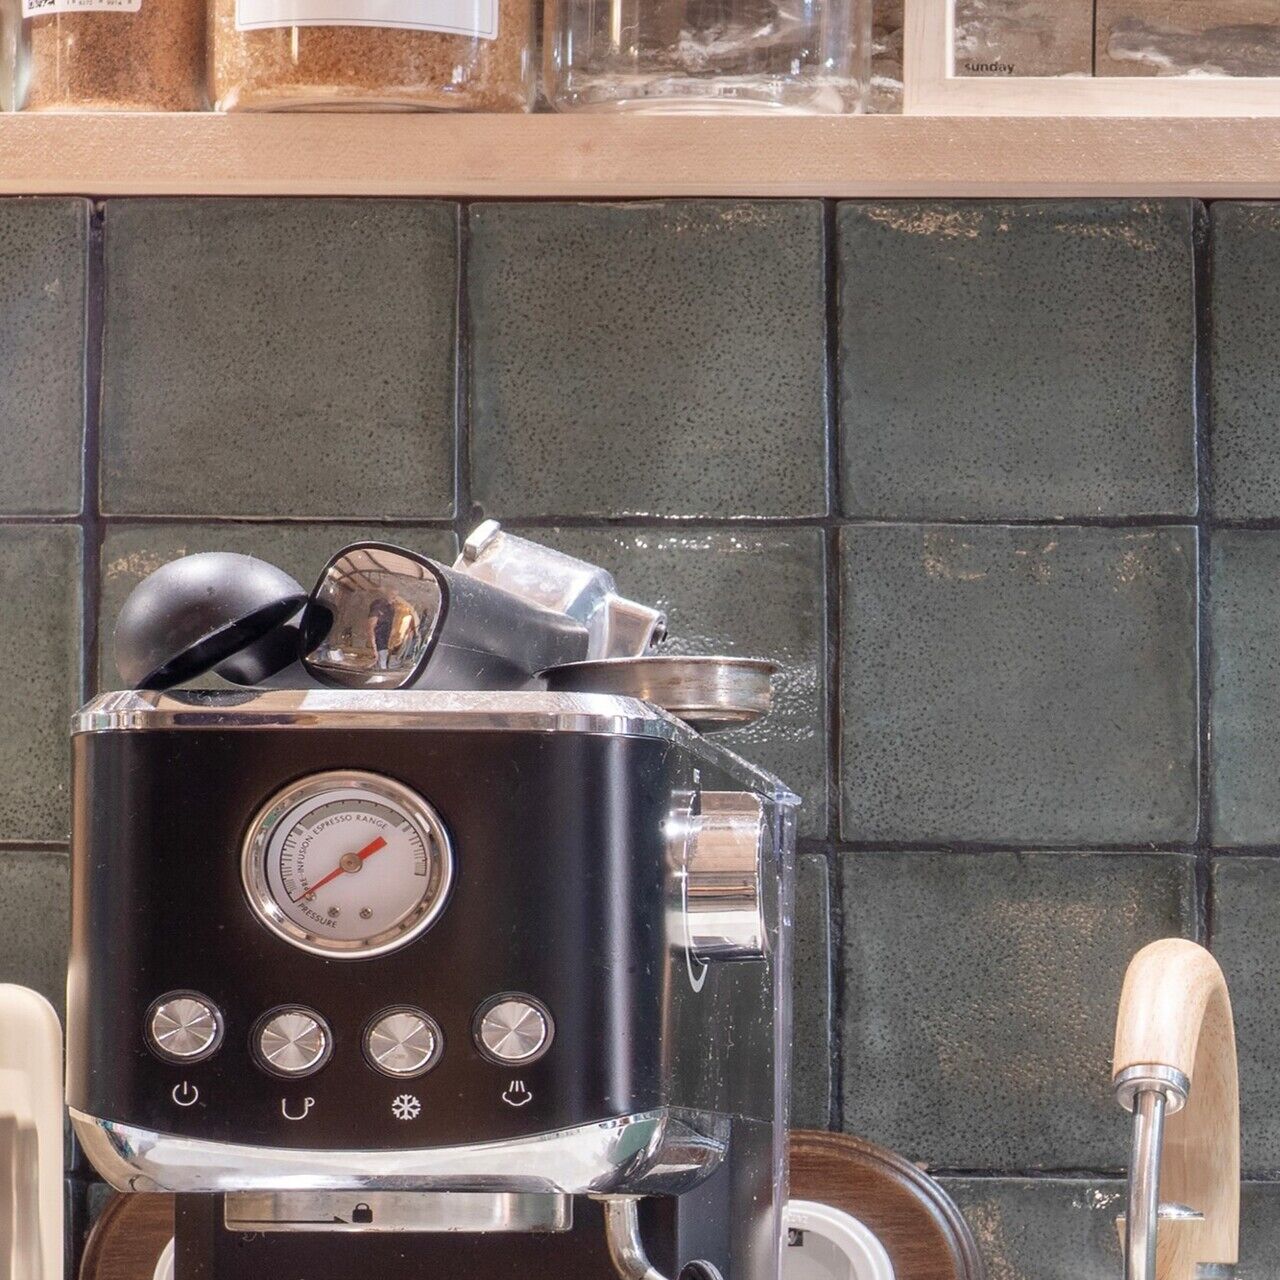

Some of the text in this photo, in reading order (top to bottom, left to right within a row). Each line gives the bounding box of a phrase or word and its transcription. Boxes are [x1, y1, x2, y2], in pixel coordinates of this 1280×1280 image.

[964, 61, 1015, 75] sunday
[312, 814, 388, 836] ESPRESSO RANGE
[298, 902, 338, 929] PRESSURE
